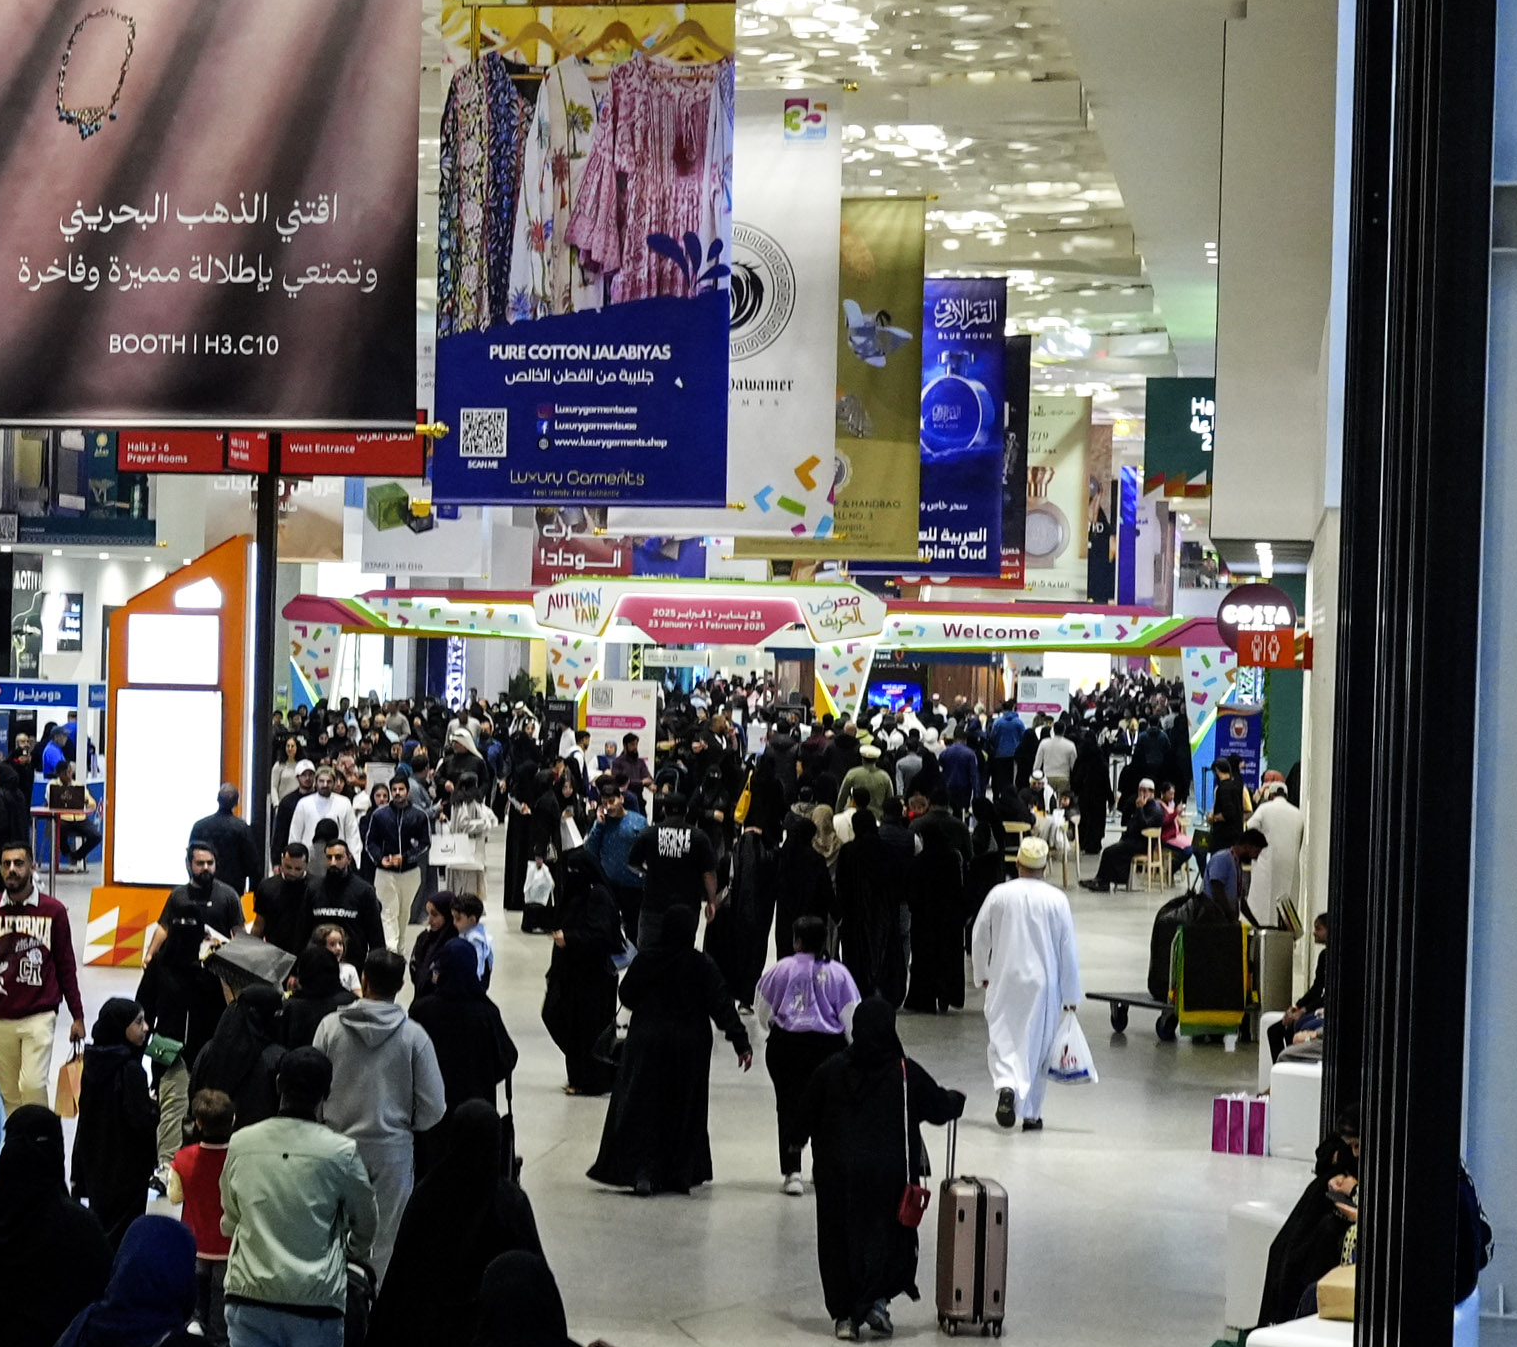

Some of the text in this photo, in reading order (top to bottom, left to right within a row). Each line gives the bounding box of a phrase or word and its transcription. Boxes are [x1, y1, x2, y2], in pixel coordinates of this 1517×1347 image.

[59, 191, 338, 243] اقتني الذهب البحريني
[18, 253, 378, 299] وتمتعي بإطلالة مميزة وفاخرة
[109, 333, 186, 354] BOOTH
[205, 333, 279, 355] H3.C10
[938, 331, 960, 340] BLUE
[489, 344, 671, 360] PURE COTTON JALABIYAS
[553, 368, 593, 385] القطن
[1191, 397, 1215, 416] Ha
[127, 442, 149, 452] Halls
[289, 443, 356, 454] West Entrance
[1201, 432, 1213, 451] 2
[127, 453, 188, 464] Prayer Rooms
[959, 545, 987, 560] Oud
[544, 586, 602, 620] AUTUMN
[808, 594, 860, 615] معرض
[653, 608, 676, 618] 2025
[1221, 604, 1292, 626] COSTA
[660, 620, 692, 631] January
[705, 620, 743, 631] February
[744, 622, 765, 631] 2025
[943, 622, 1041, 640] Welcome
